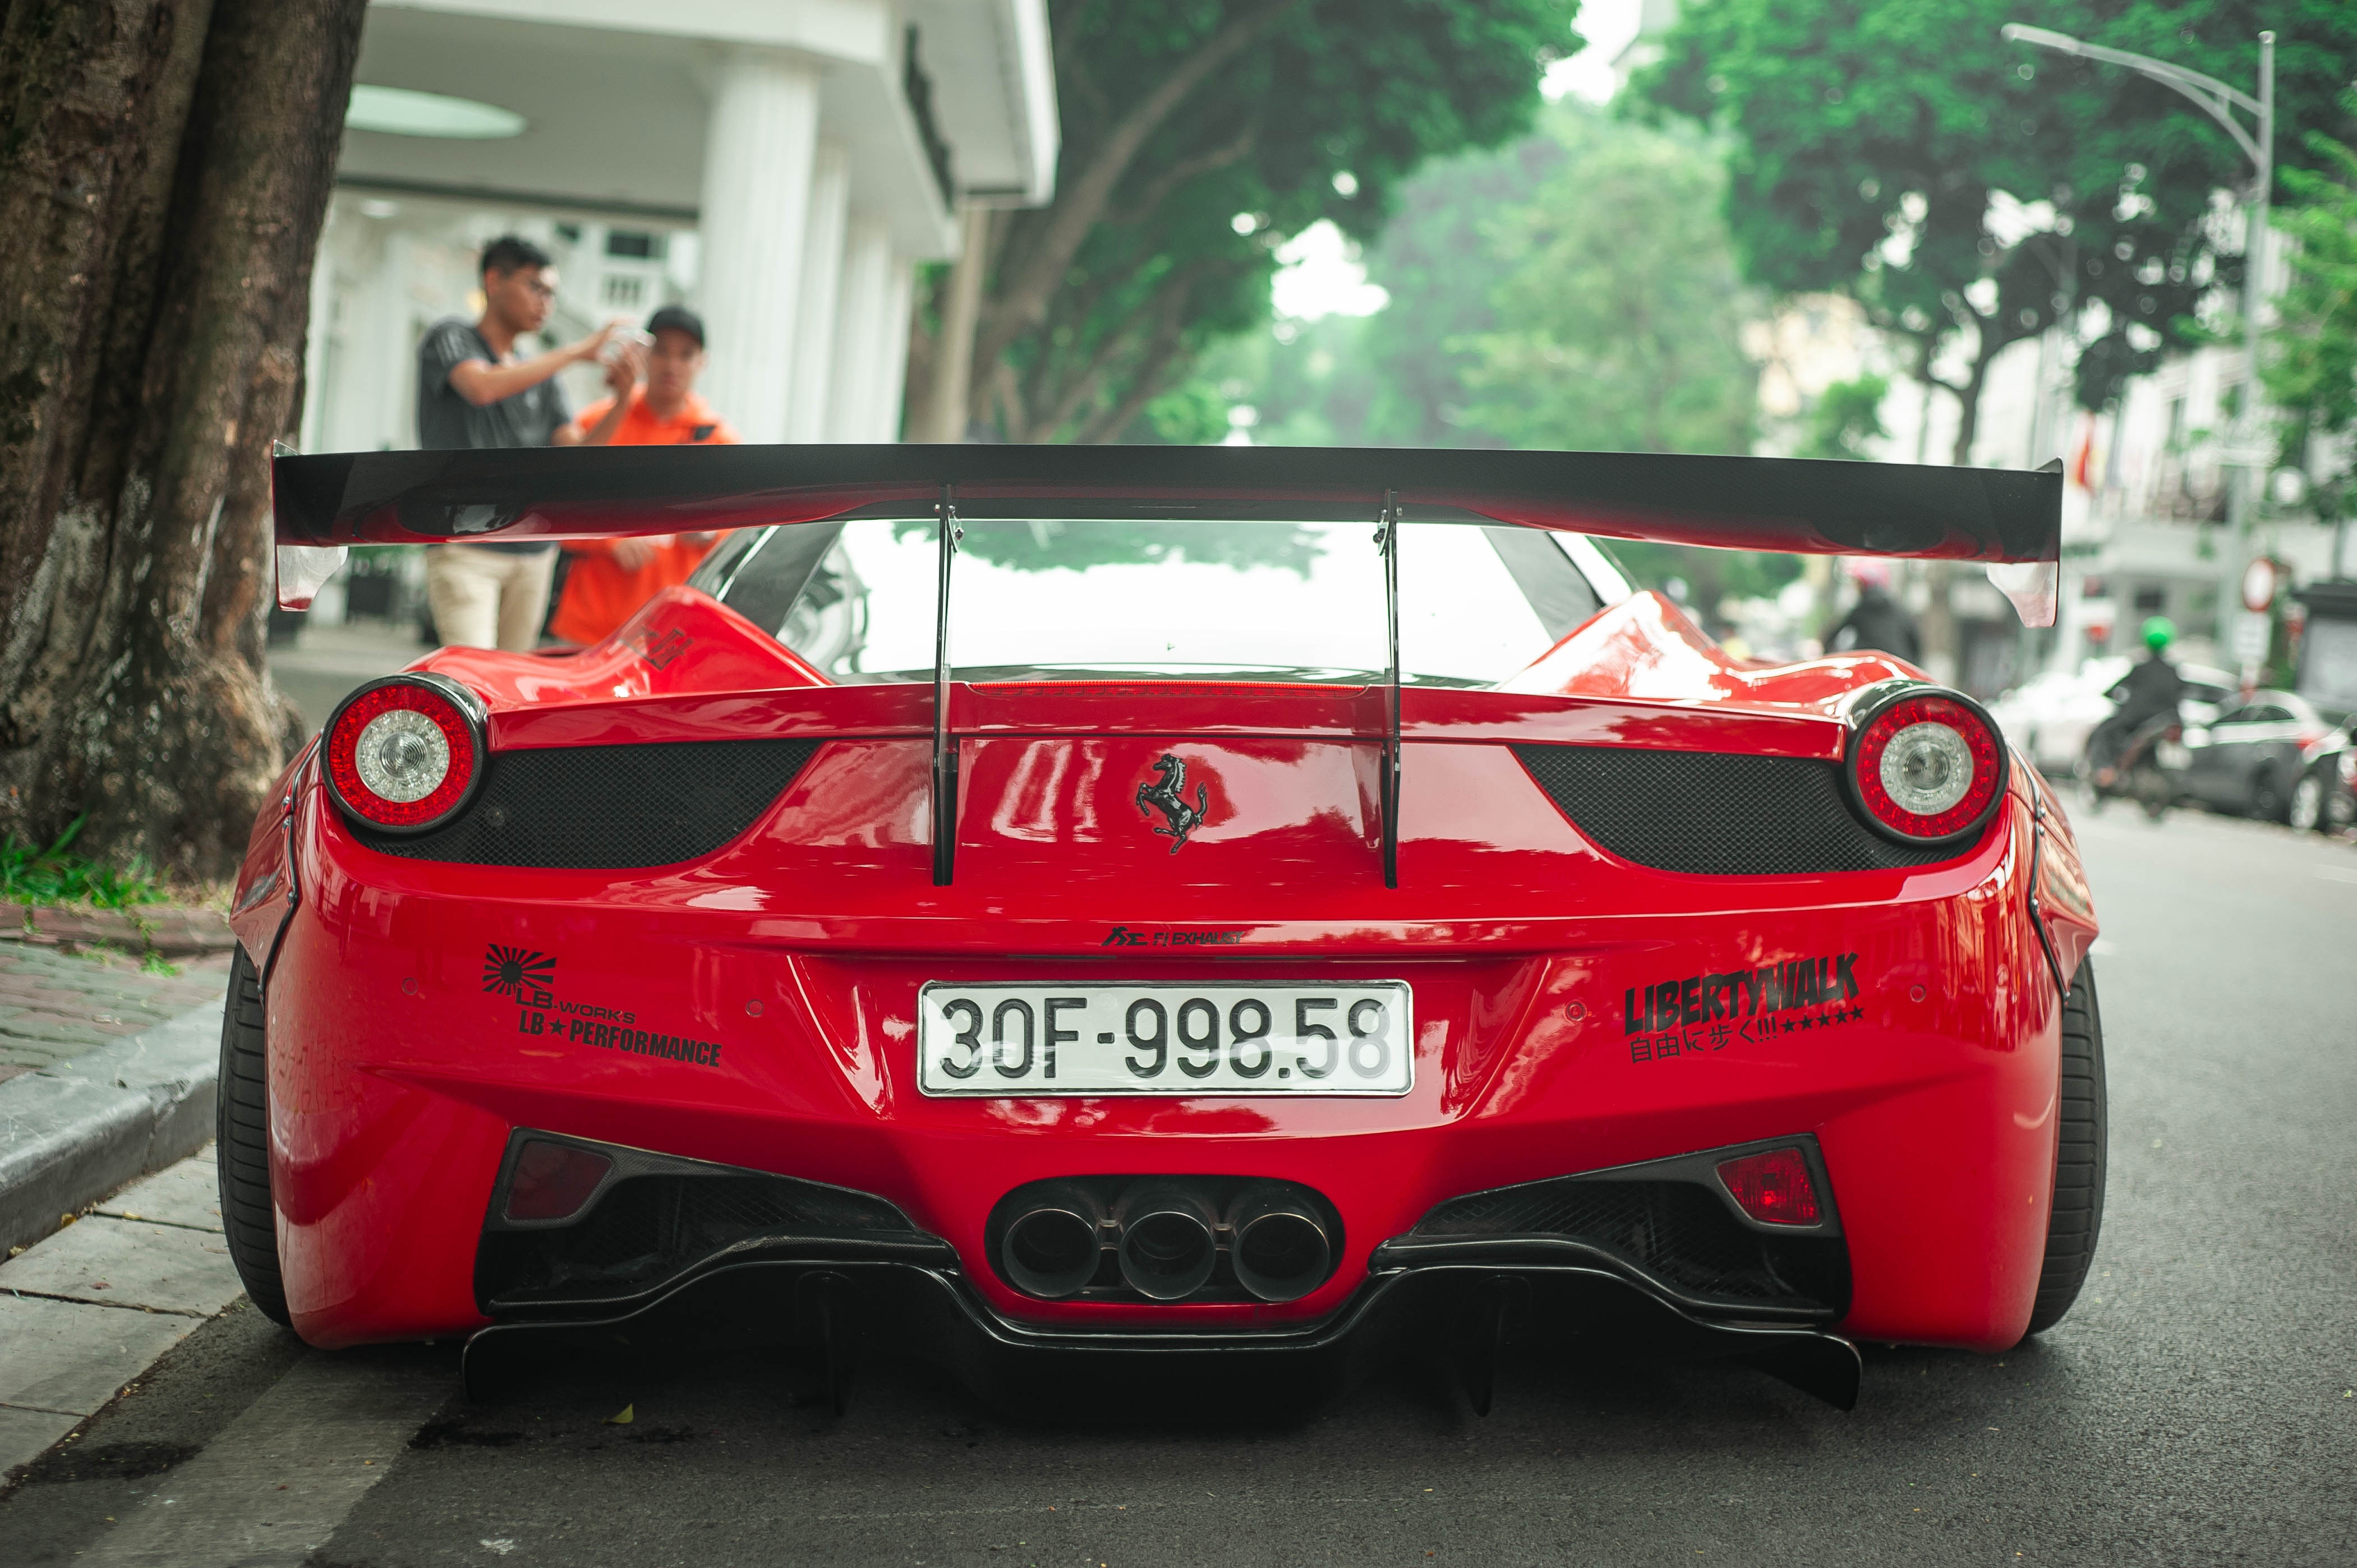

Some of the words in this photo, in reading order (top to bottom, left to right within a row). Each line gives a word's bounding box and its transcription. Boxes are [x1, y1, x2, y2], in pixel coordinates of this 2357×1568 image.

[1171, 931, 1244, 945] EXHAUST
[1624, 952, 1859, 1036] LIBERTYWALK
[569, 1018, 722, 1067] PERFORMANCE
[941, 997, 1391, 1080] 30F-998.58
